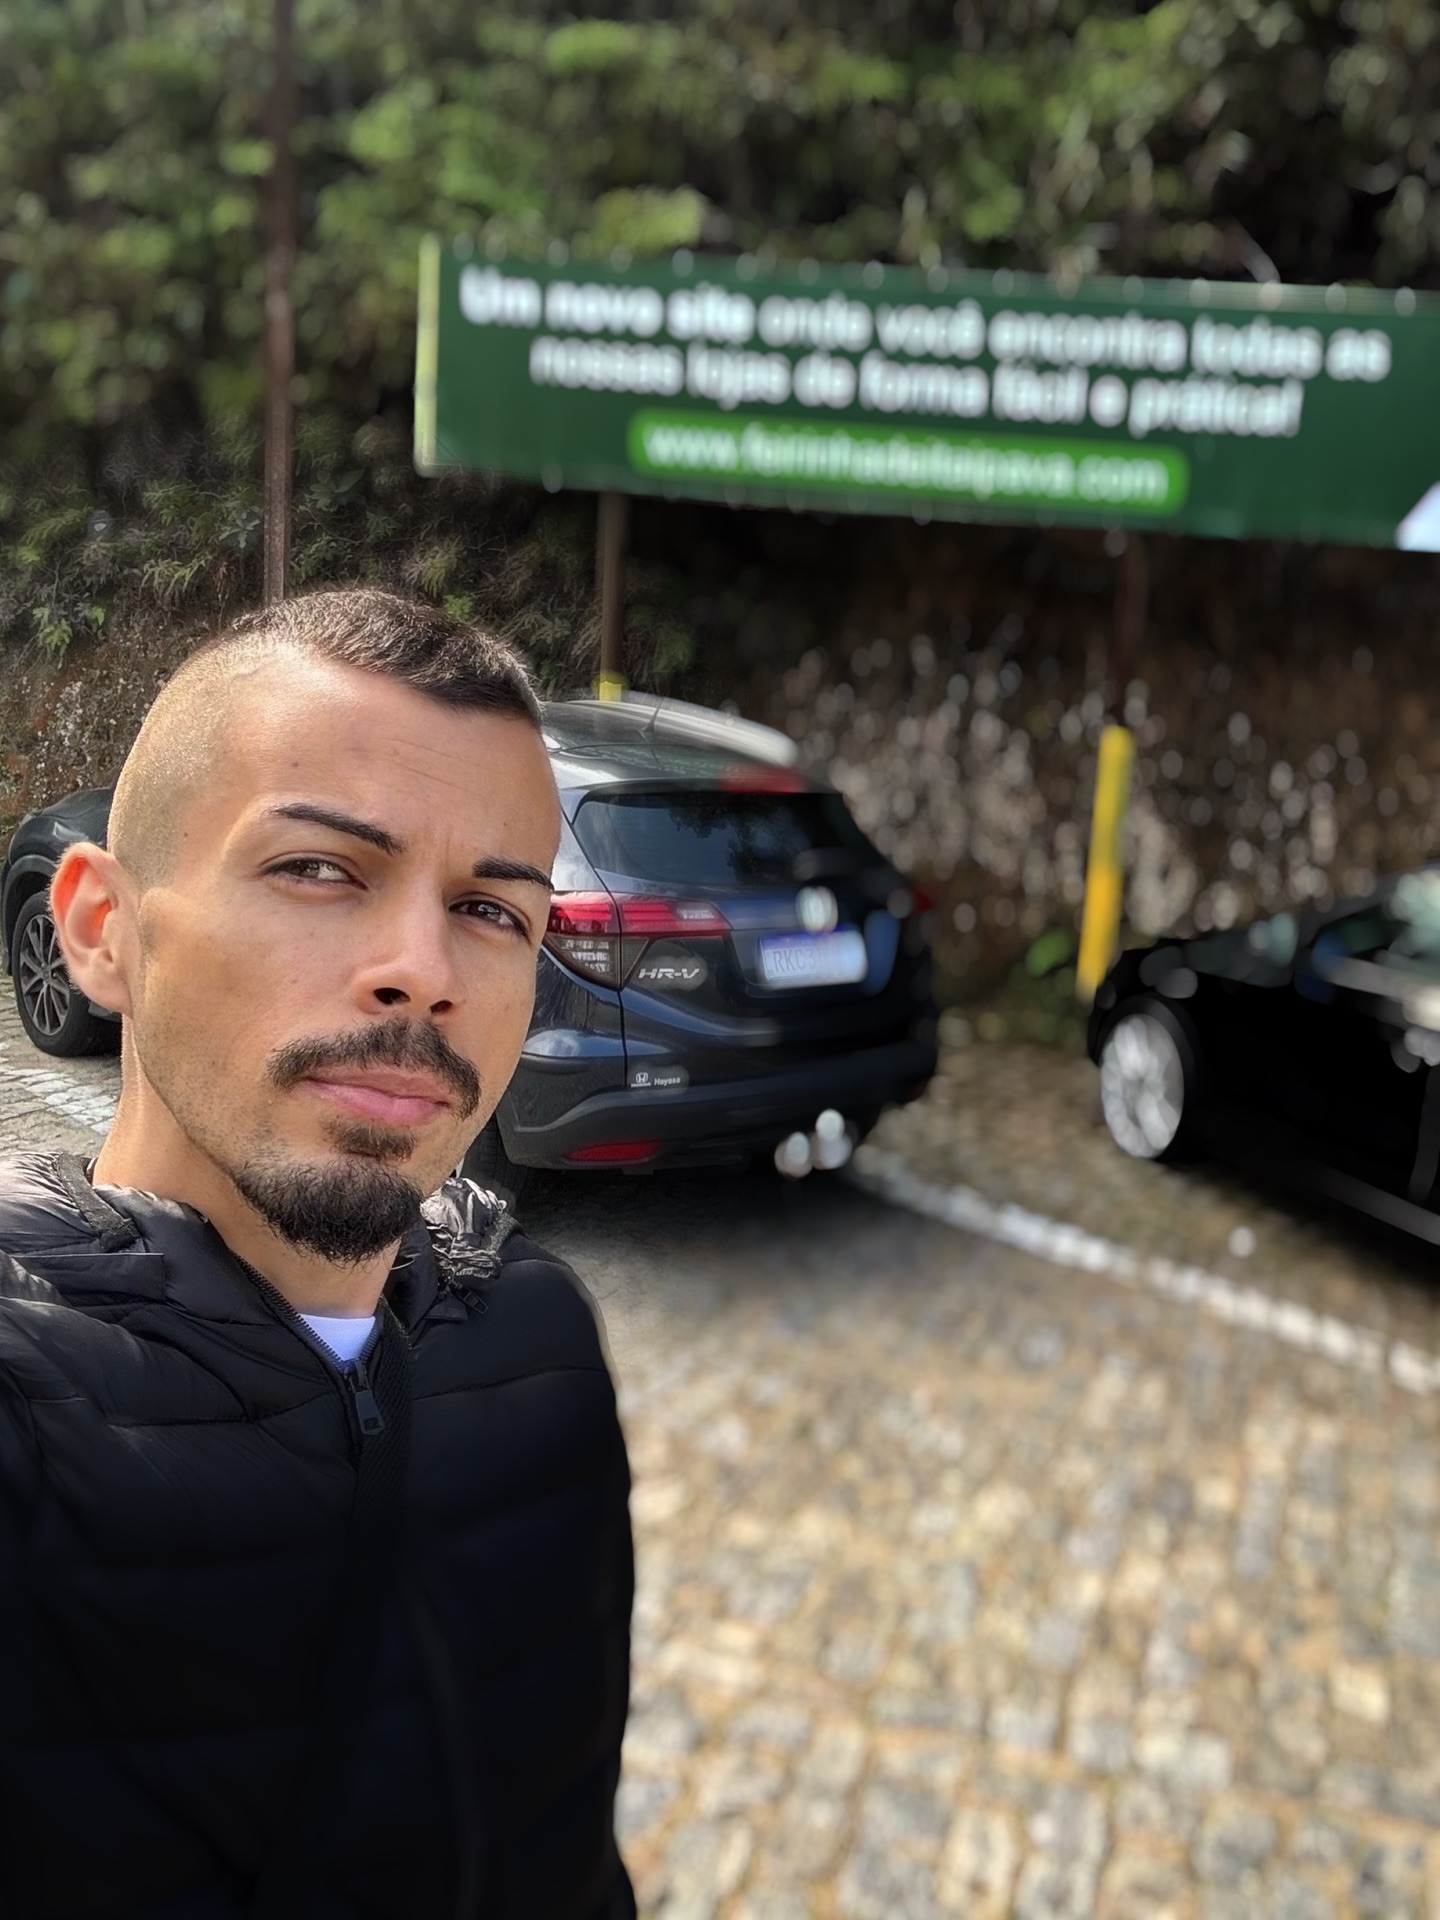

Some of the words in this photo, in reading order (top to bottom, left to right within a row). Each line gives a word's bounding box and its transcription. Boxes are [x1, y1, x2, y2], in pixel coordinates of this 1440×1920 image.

[460, 265, 541, 328] Um
[545, 281, 663, 337] novo
[667, 281, 755, 345] site
[758, 291, 872, 353] onde
[877, 299, 985, 360] você
[988, 310, 1187, 371] encontra
[1191, 314, 1322, 379] todas
[1326, 327, 1391, 382] as
[530, 336, 683, 396] nossas
[687, 342, 791, 410] lojas
[795, 350, 856, 408] de
[860, 350, 989, 418] forma
[992, 361, 1088, 424] fácil
[1090, 375, 1128, 427] e
[1129, 374, 1304, 438] prática!
[638, 968, 700, 979] HR-V
